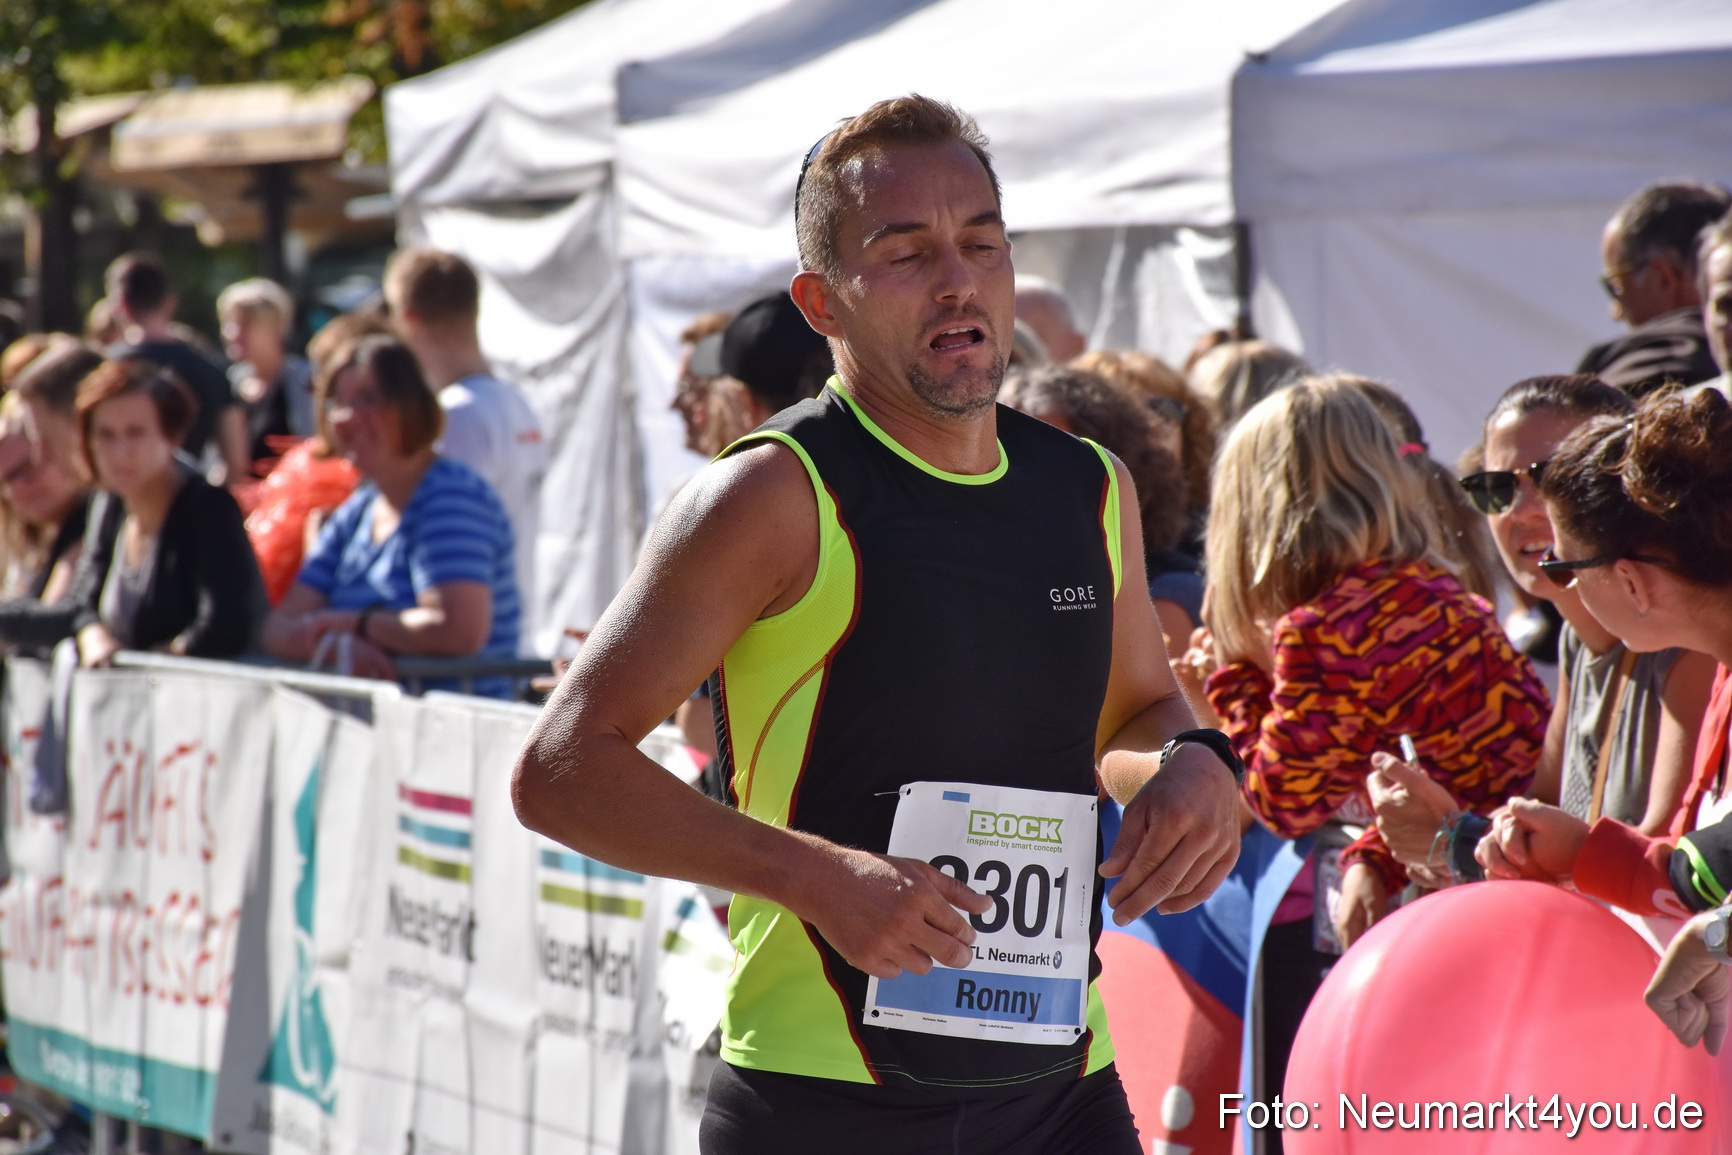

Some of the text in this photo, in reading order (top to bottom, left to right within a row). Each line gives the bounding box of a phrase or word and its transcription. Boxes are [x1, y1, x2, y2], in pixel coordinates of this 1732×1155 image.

[1049, 585, 1096, 603] GORE
[1083, 602, 1097, 610] WEAR
[968, 810, 1064, 844] BOCK
[966, 836, 1063, 854] inspired by smart concepts
[988, 947, 1051, 966] Neumarkt
[955, 978, 1042, 1022] Ronny
